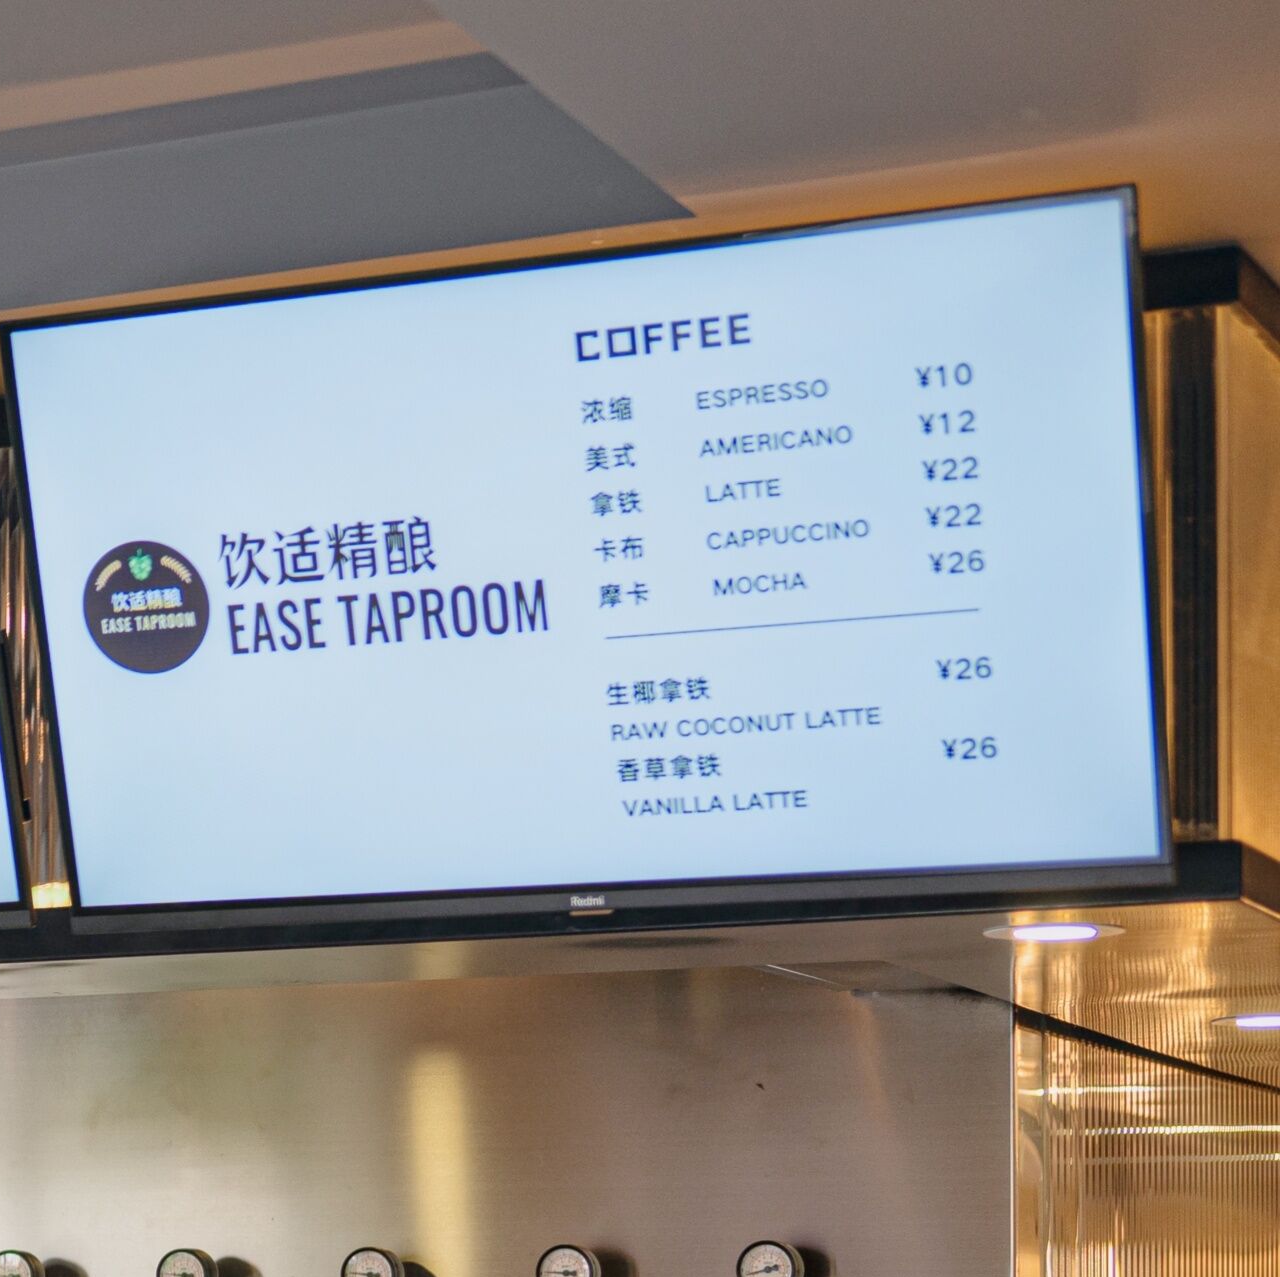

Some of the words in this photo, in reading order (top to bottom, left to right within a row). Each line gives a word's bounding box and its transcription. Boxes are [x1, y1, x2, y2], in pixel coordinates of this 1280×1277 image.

[574, 313, 752, 363] COFFEE
[580, 396, 634, 424] 浓缩
[695, 379, 829, 410] ESPRESSO
[914, 362, 973, 388] ¥10
[585, 443, 637, 472] 美式
[699, 425, 854, 458] AMERICANO
[919, 409, 976, 436] ¥12
[590, 491, 643, 516] 拿铁
[704, 478, 781, 503] LATTE
[921, 456, 980, 481] ¥22
[218, 515, 439, 590] 饮适精酿
[594, 537, 644, 562] 卡布
[706, 519, 870, 551] CAPPUCCINO
[925, 503, 983, 528] ¥22
[598, 583, 649, 609] 摩卡
[713, 572, 808, 597] MOCHA
[929, 550, 985, 574] ¥26
[101, 617, 133, 634] EASE
[134, 611, 197, 631] TAPROOM
[226, 598, 328, 655] EASE
[337, 578, 550, 646] TAPROOM
[606, 677, 712, 707] 生椰拿铁
[935, 657, 994, 681] ¥26
[610, 722, 668, 741] RAW
[677, 712, 796, 738] COCONUT
[805, 707, 882, 729] LATTE
[617, 754, 722, 783] 香草拿铁
[941, 737, 999, 760] ¥26
[621, 794, 725, 817] VANILLA
[732, 789, 808, 811] LATTE
